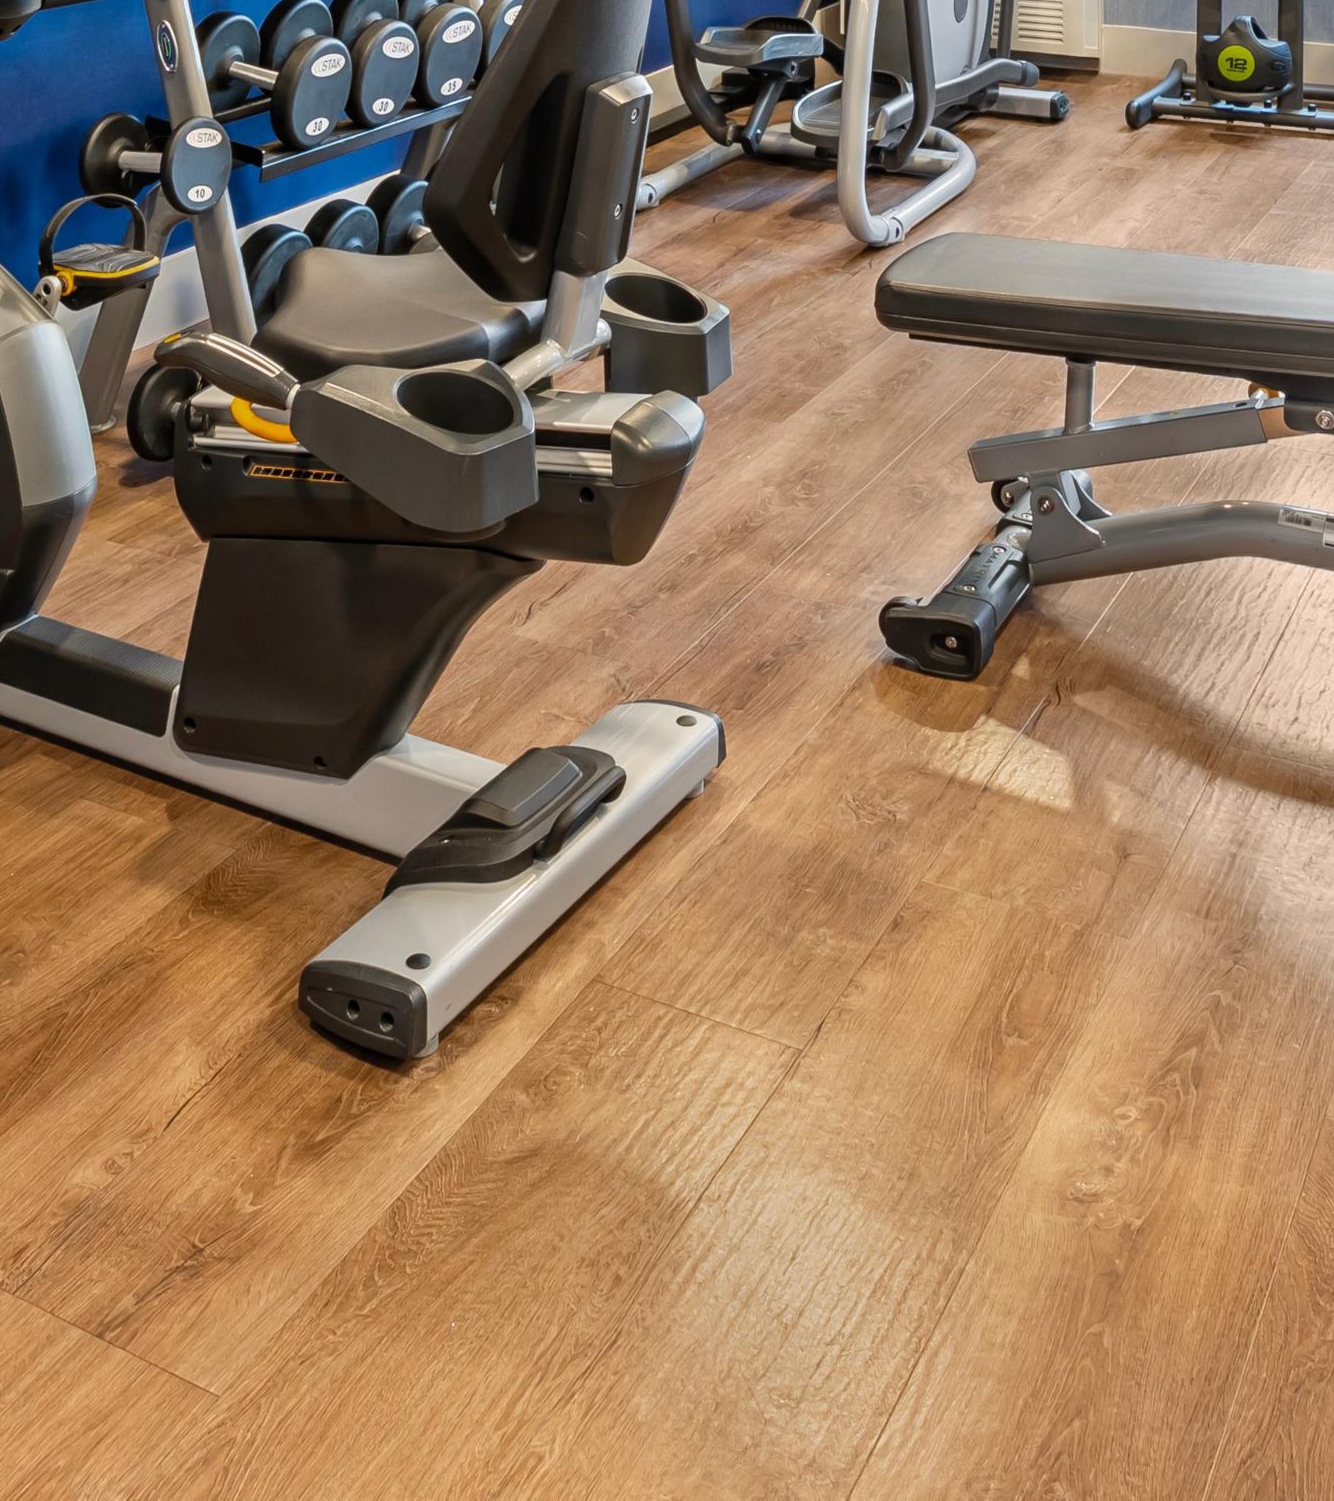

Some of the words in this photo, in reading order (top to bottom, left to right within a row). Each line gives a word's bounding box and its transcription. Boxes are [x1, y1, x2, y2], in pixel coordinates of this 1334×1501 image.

[1225, 57, 1247, 70] 12
[379, 101, 389, 112] 30
[312, 120, 323, 132] 30
[195, 188, 205, 198] 10
